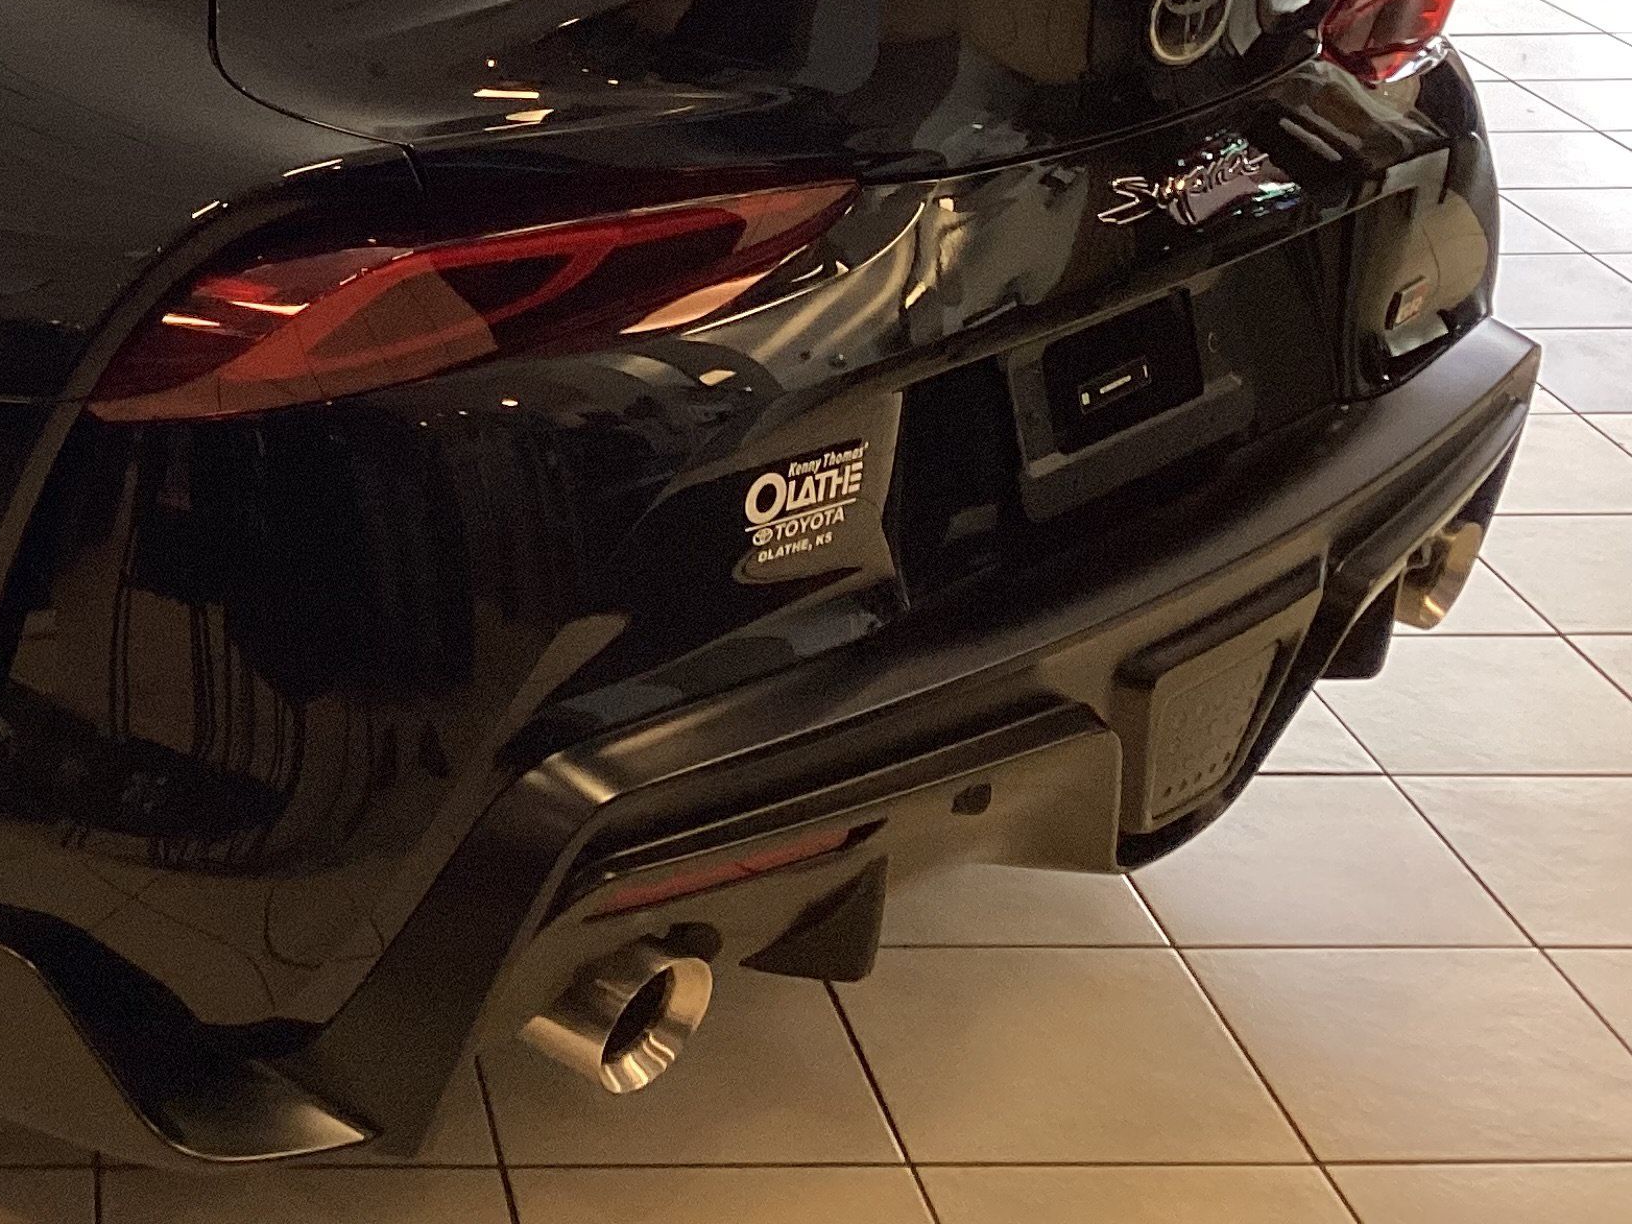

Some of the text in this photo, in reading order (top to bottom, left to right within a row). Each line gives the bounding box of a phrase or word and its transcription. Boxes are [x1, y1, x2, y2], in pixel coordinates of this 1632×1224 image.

[788, 459, 821, 478] Kenny
[745, 461, 864, 525] OLATHE
[776, 507, 845, 540] TOYOTA
[757, 532, 833, 564] OLATHE, KS
